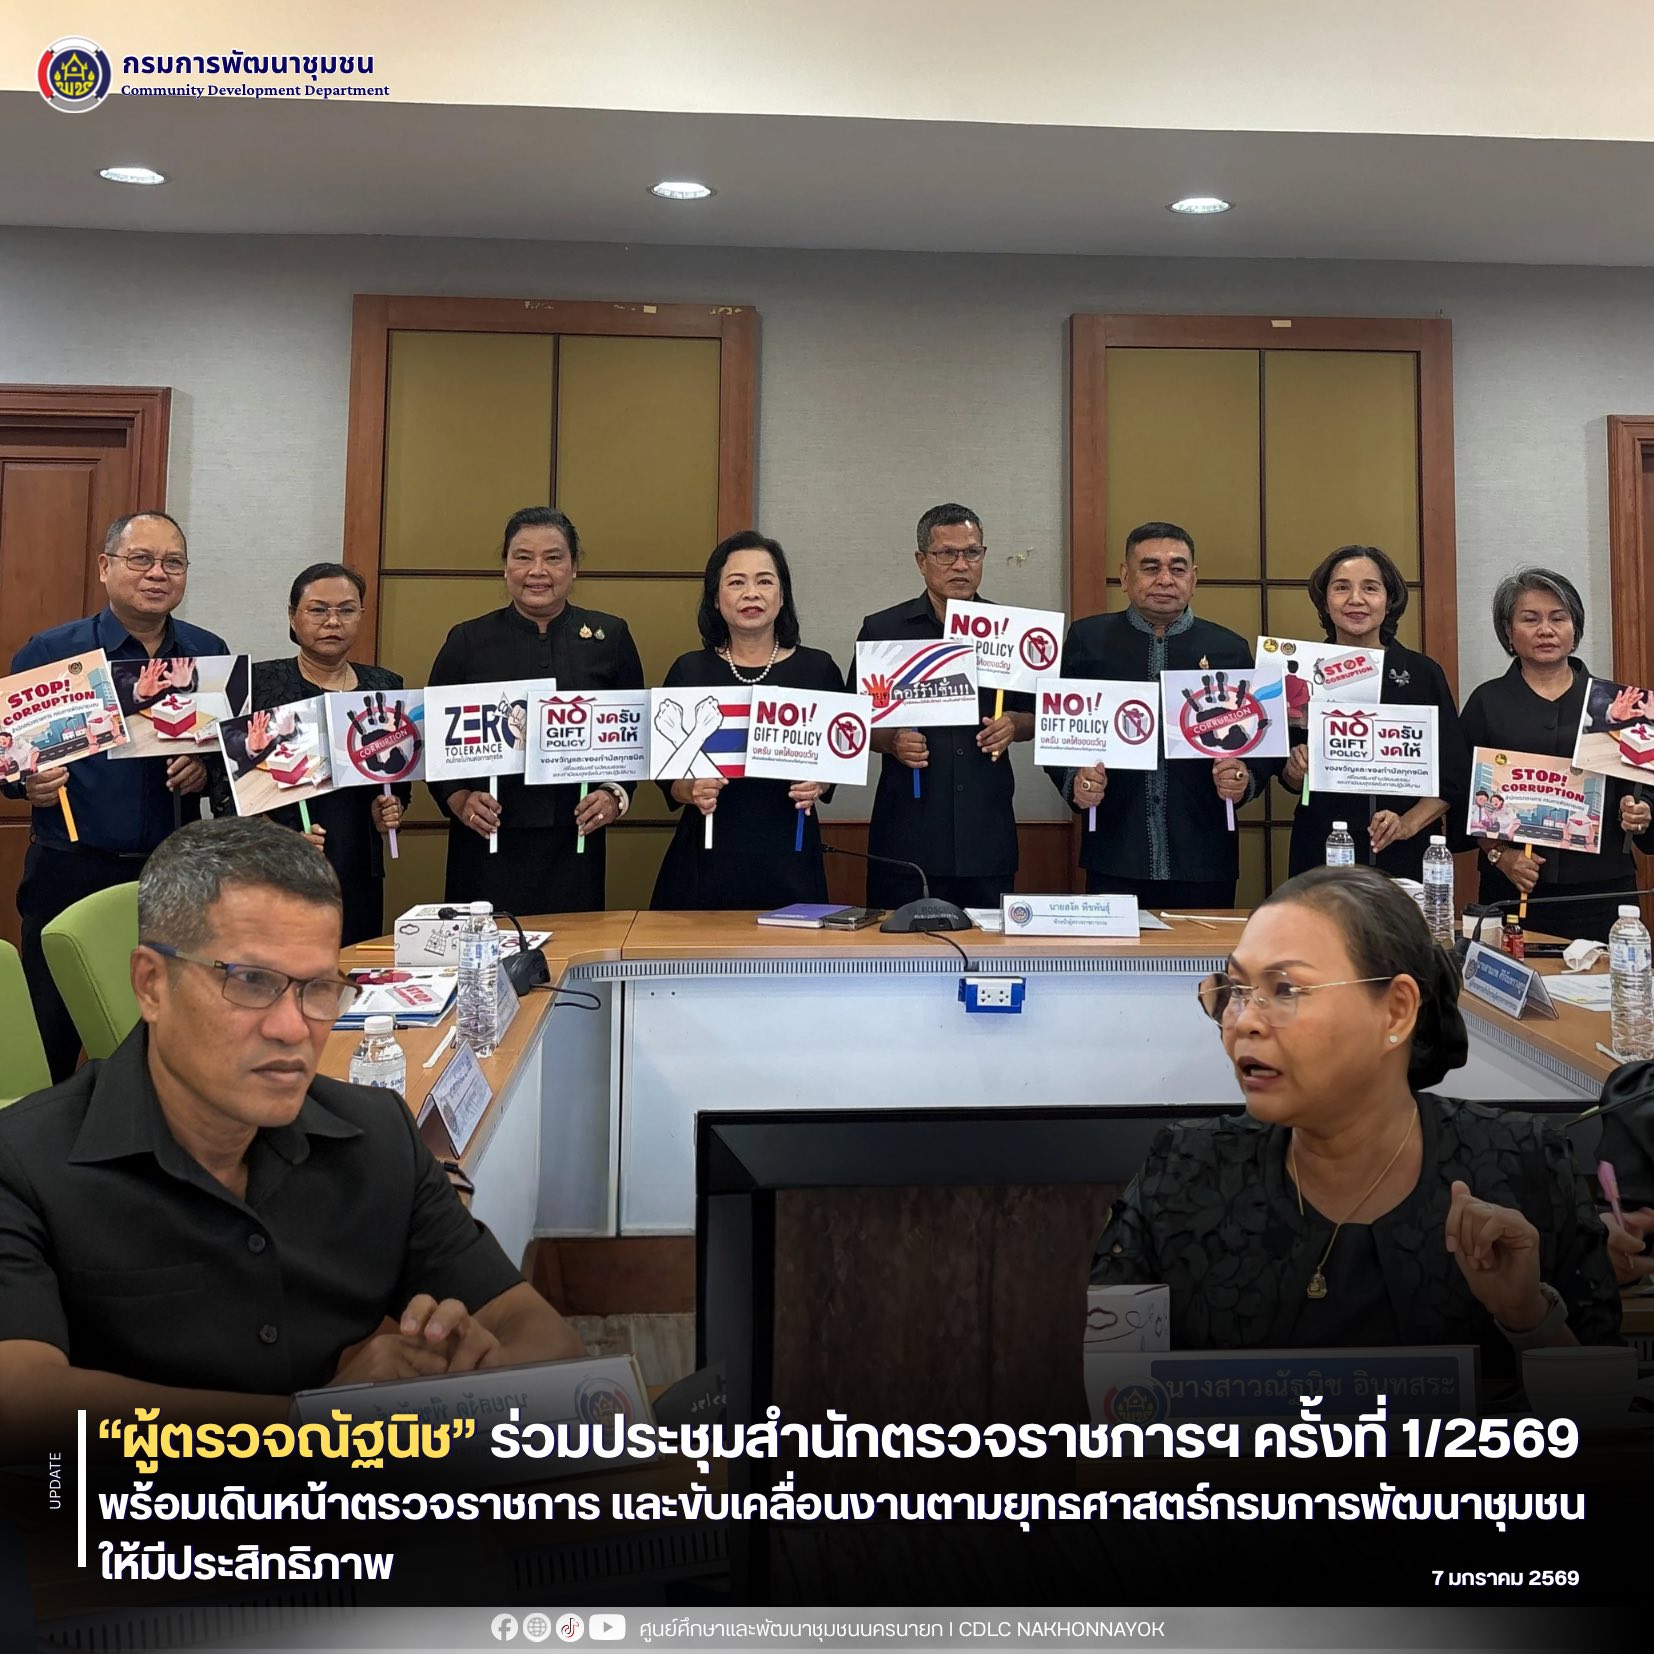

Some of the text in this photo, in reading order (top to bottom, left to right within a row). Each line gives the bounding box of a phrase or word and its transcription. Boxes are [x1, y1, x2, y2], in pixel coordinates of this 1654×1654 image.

[976, 642, 1014, 658] POLICY
[1325, 666, 1373, 684] CORRUPTION
[7, 679, 71, 709] STOP!
[3, 691, 95, 726] CORRUPTION
[547, 703, 587, 725] NO
[596, 709, 641, 724] งดรับ
[1040, 717, 1109, 735] GIFT POLICY
[1192, 706, 1252, 735] CORRUPTION
[1329, 717, 1369, 738] NO
[546, 727, 585, 738] GIFT
[598, 726, 638, 743] งดให้
[753, 727, 822, 747] GIFT POLICY
[1377, 725, 1423, 740] งดรับ
[359, 729, 408, 759] CORRUPTION
[445, 743, 503, 757] TOLERANCE
[546, 739, 586, 748] POLICY
[1329, 738, 1367, 749] GIFT
[1380, 742, 1421, 758] งดให้
[1329, 749, 1368, 758] POLICY
[1511, 768, 1568, 787] STOP!
[1501, 783, 1585, 803] CORRUPTION
